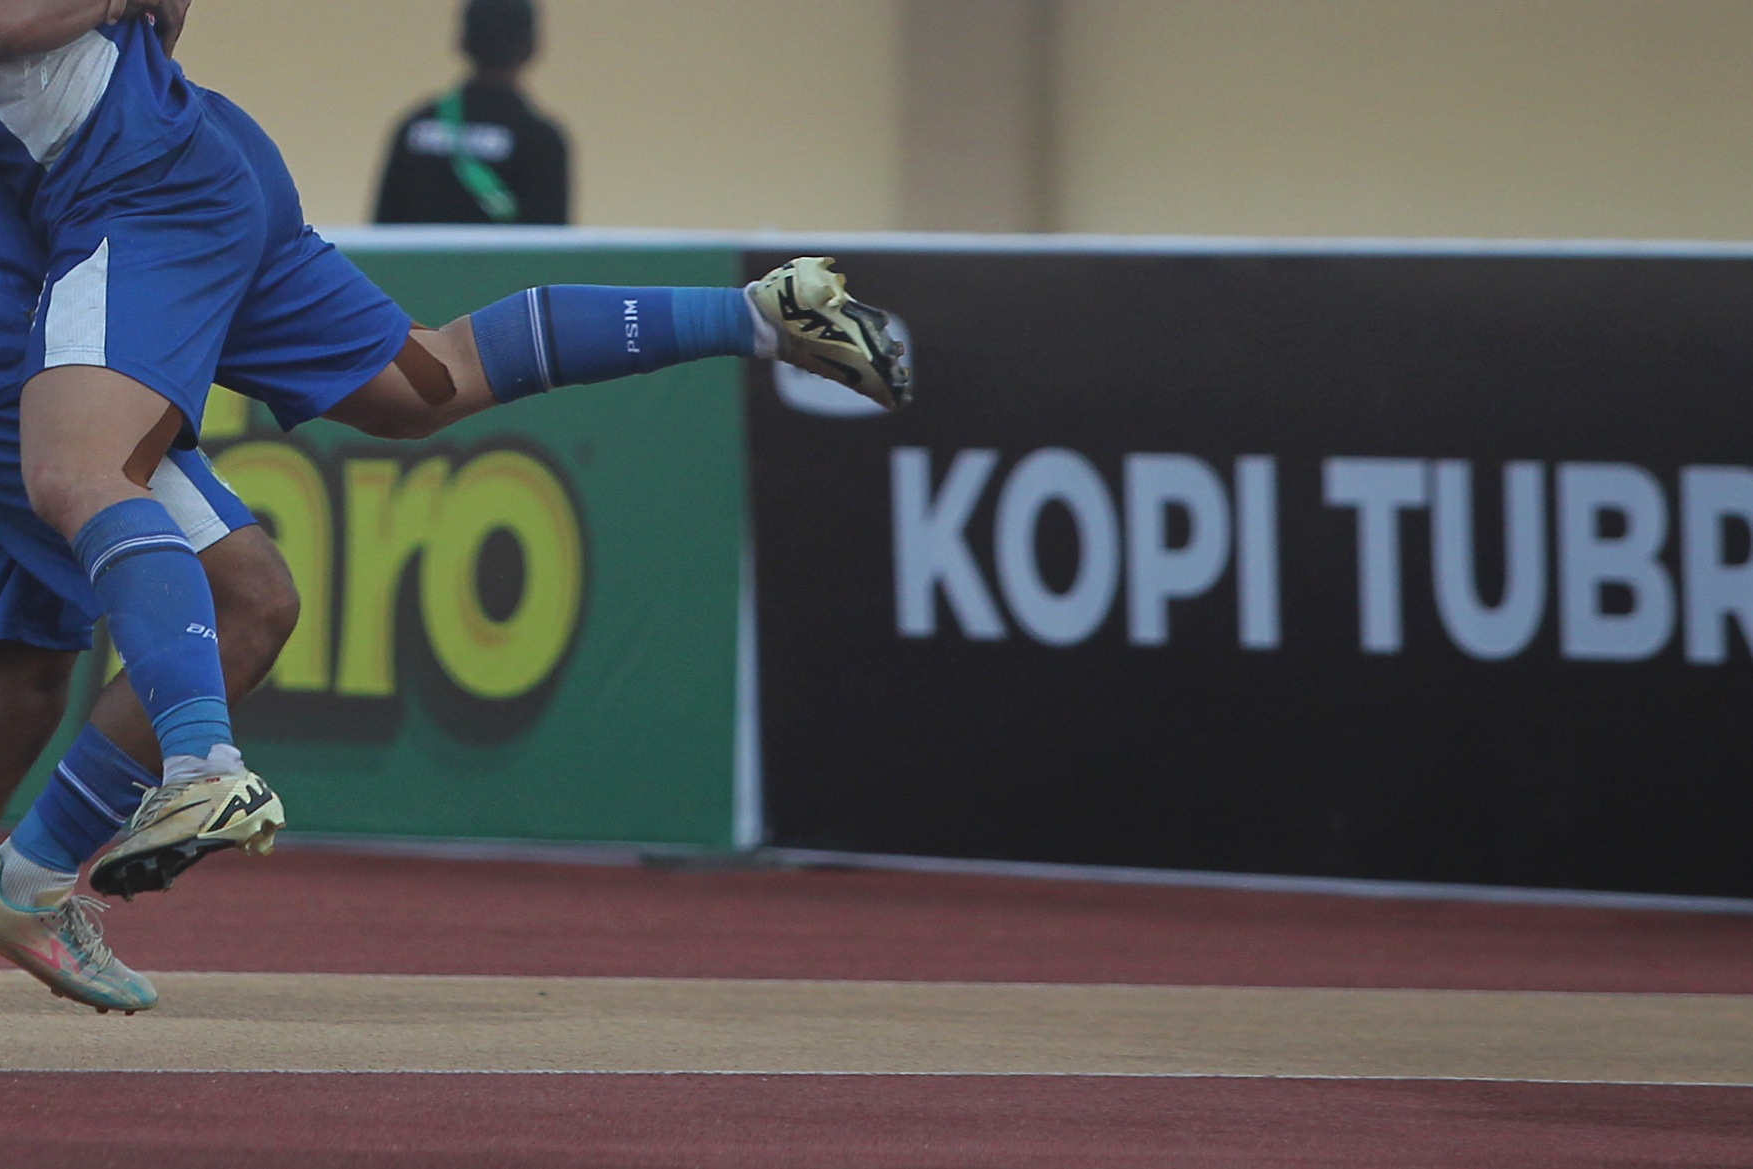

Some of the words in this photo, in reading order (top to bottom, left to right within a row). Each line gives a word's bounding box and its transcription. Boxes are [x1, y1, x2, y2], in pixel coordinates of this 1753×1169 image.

[623, 299, 640, 353] PSIM
[107, 382, 583, 700] aro
[890, 446, 1283, 650] KOPI
